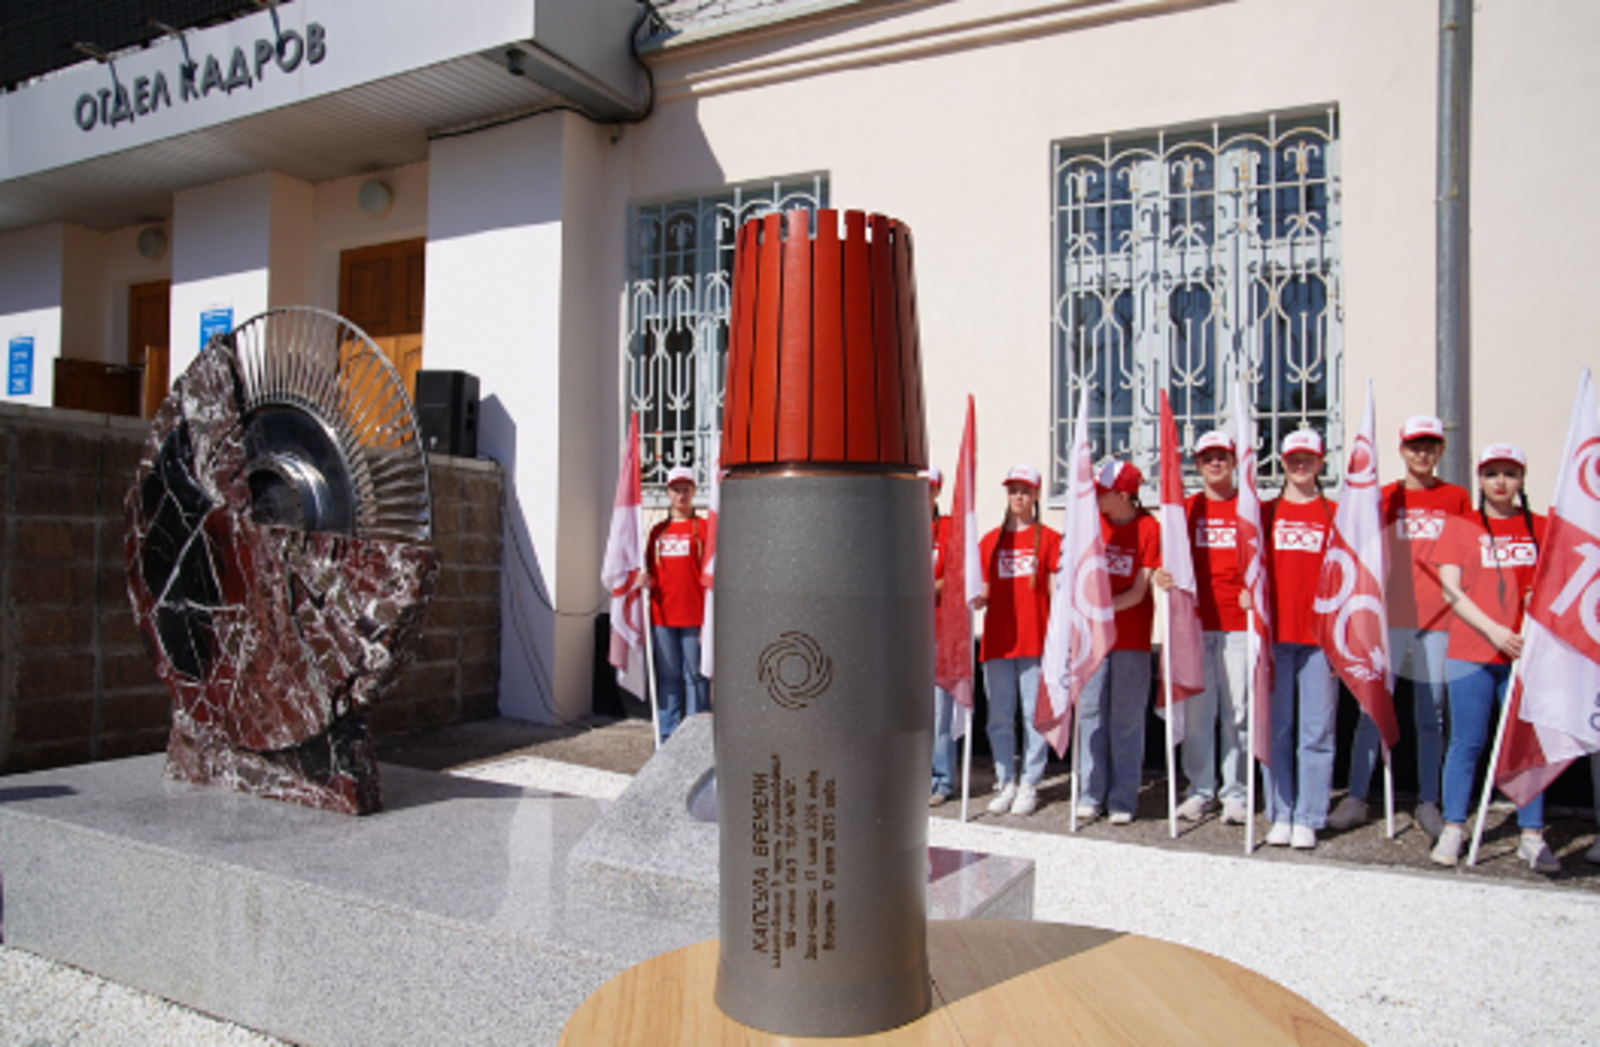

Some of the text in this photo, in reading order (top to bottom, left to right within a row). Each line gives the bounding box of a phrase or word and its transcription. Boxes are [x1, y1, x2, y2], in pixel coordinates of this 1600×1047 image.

[75, 22, 326, 131] ОТДЕЛ КАДРОВ
[752, 773, 768, 954] КАПСУЛА ВРЕМЕНИ
